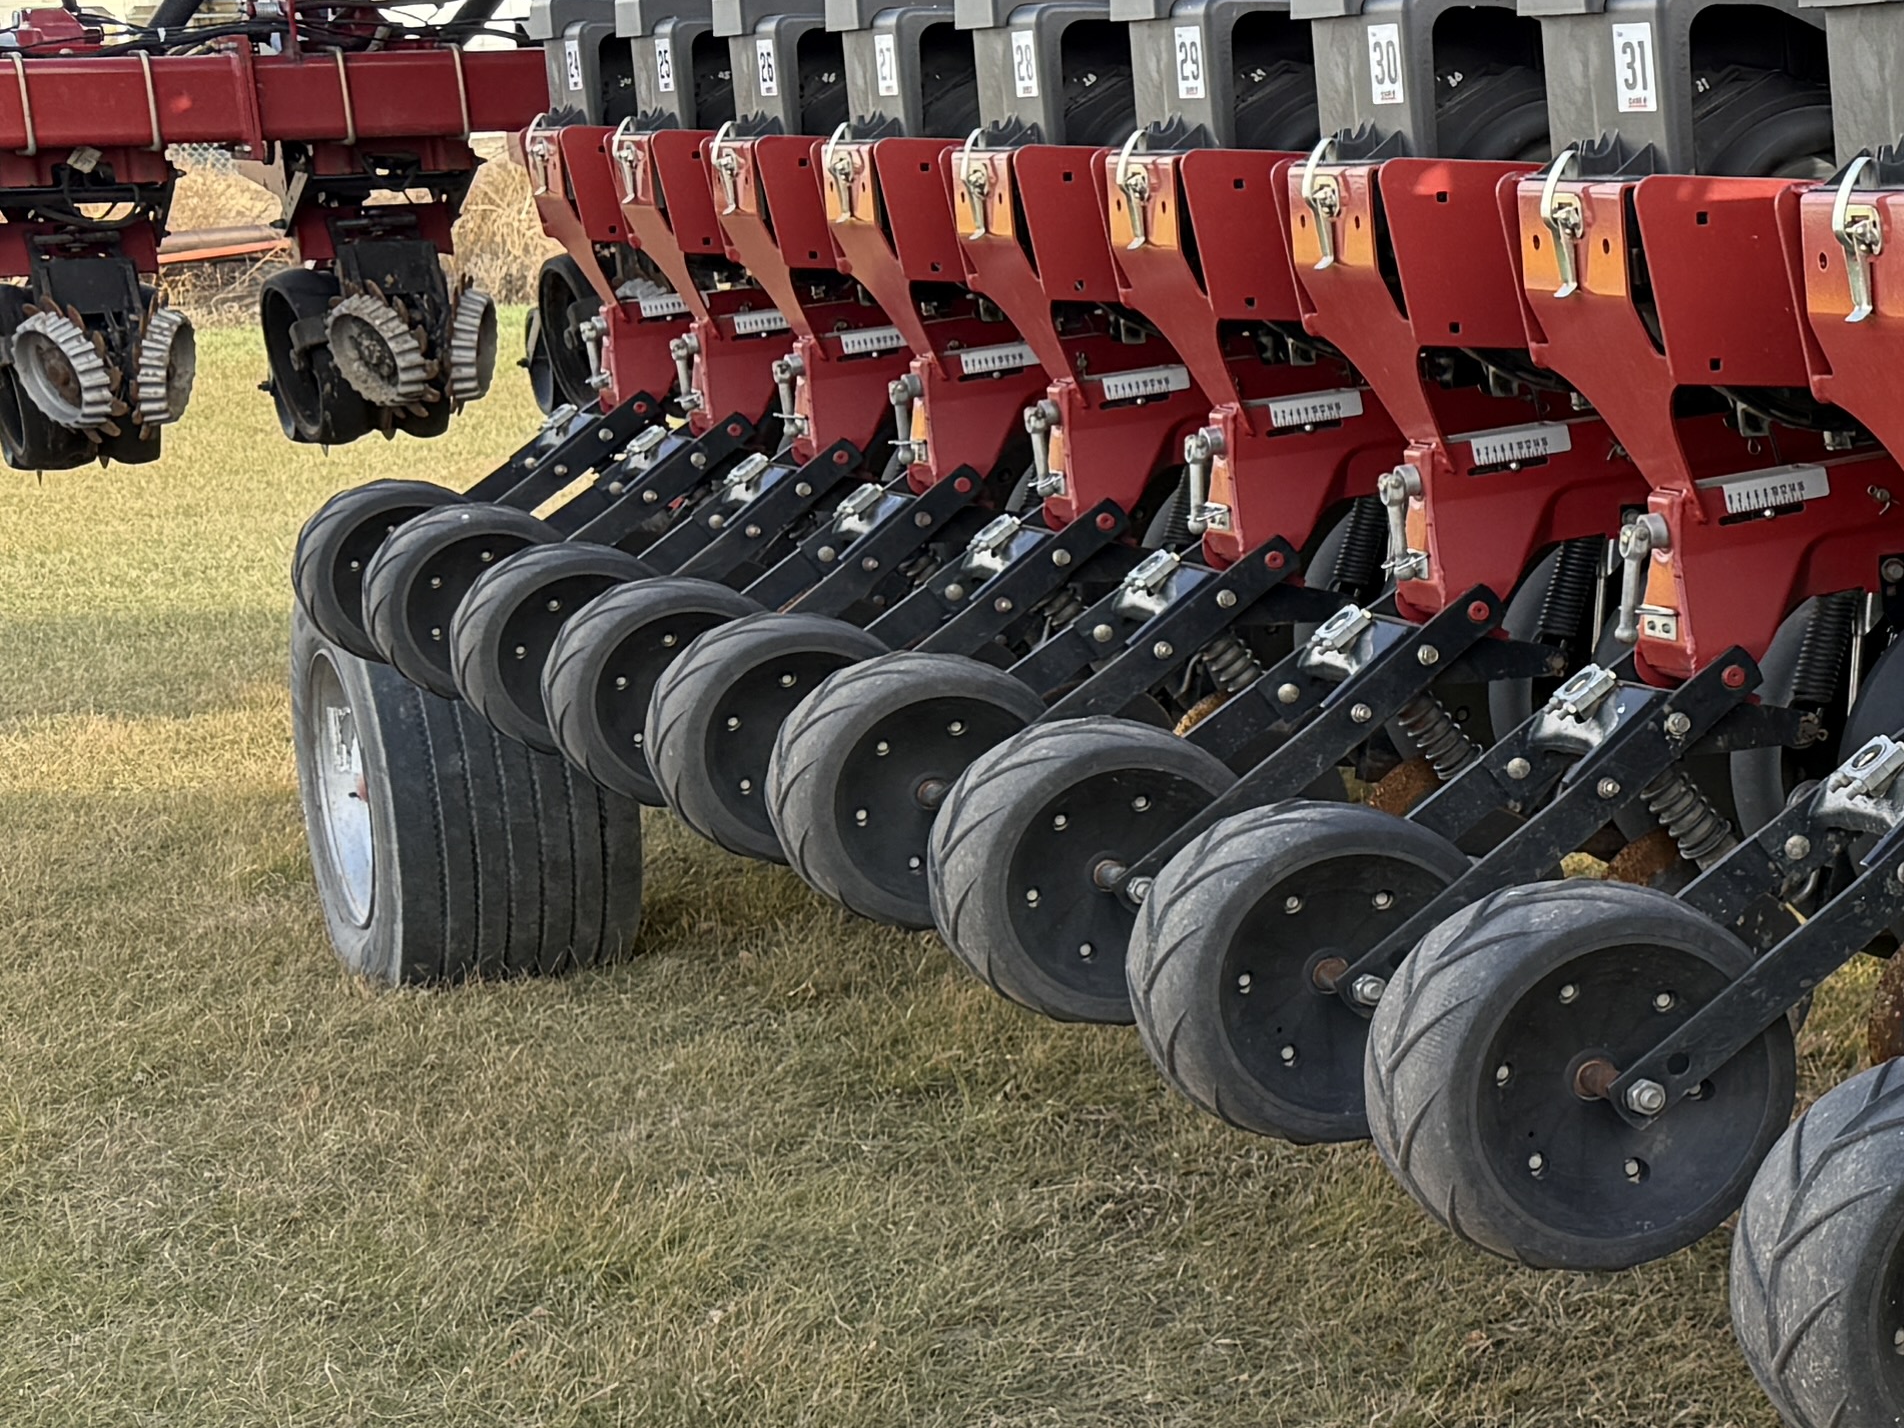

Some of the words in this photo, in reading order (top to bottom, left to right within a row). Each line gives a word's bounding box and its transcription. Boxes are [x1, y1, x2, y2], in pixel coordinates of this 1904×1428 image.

[567, 50, 580, 79] 24
[657, 49, 671, 79] 25
[759, 51, 774, 83] 26
[878, 47, 893, 82] 27
[1015, 44, 1034, 82] 28
[1179, 41, 1200, 82] 29
[1373, 39, 1398, 86] 30
[1621, 40, 1648, 91] 31
